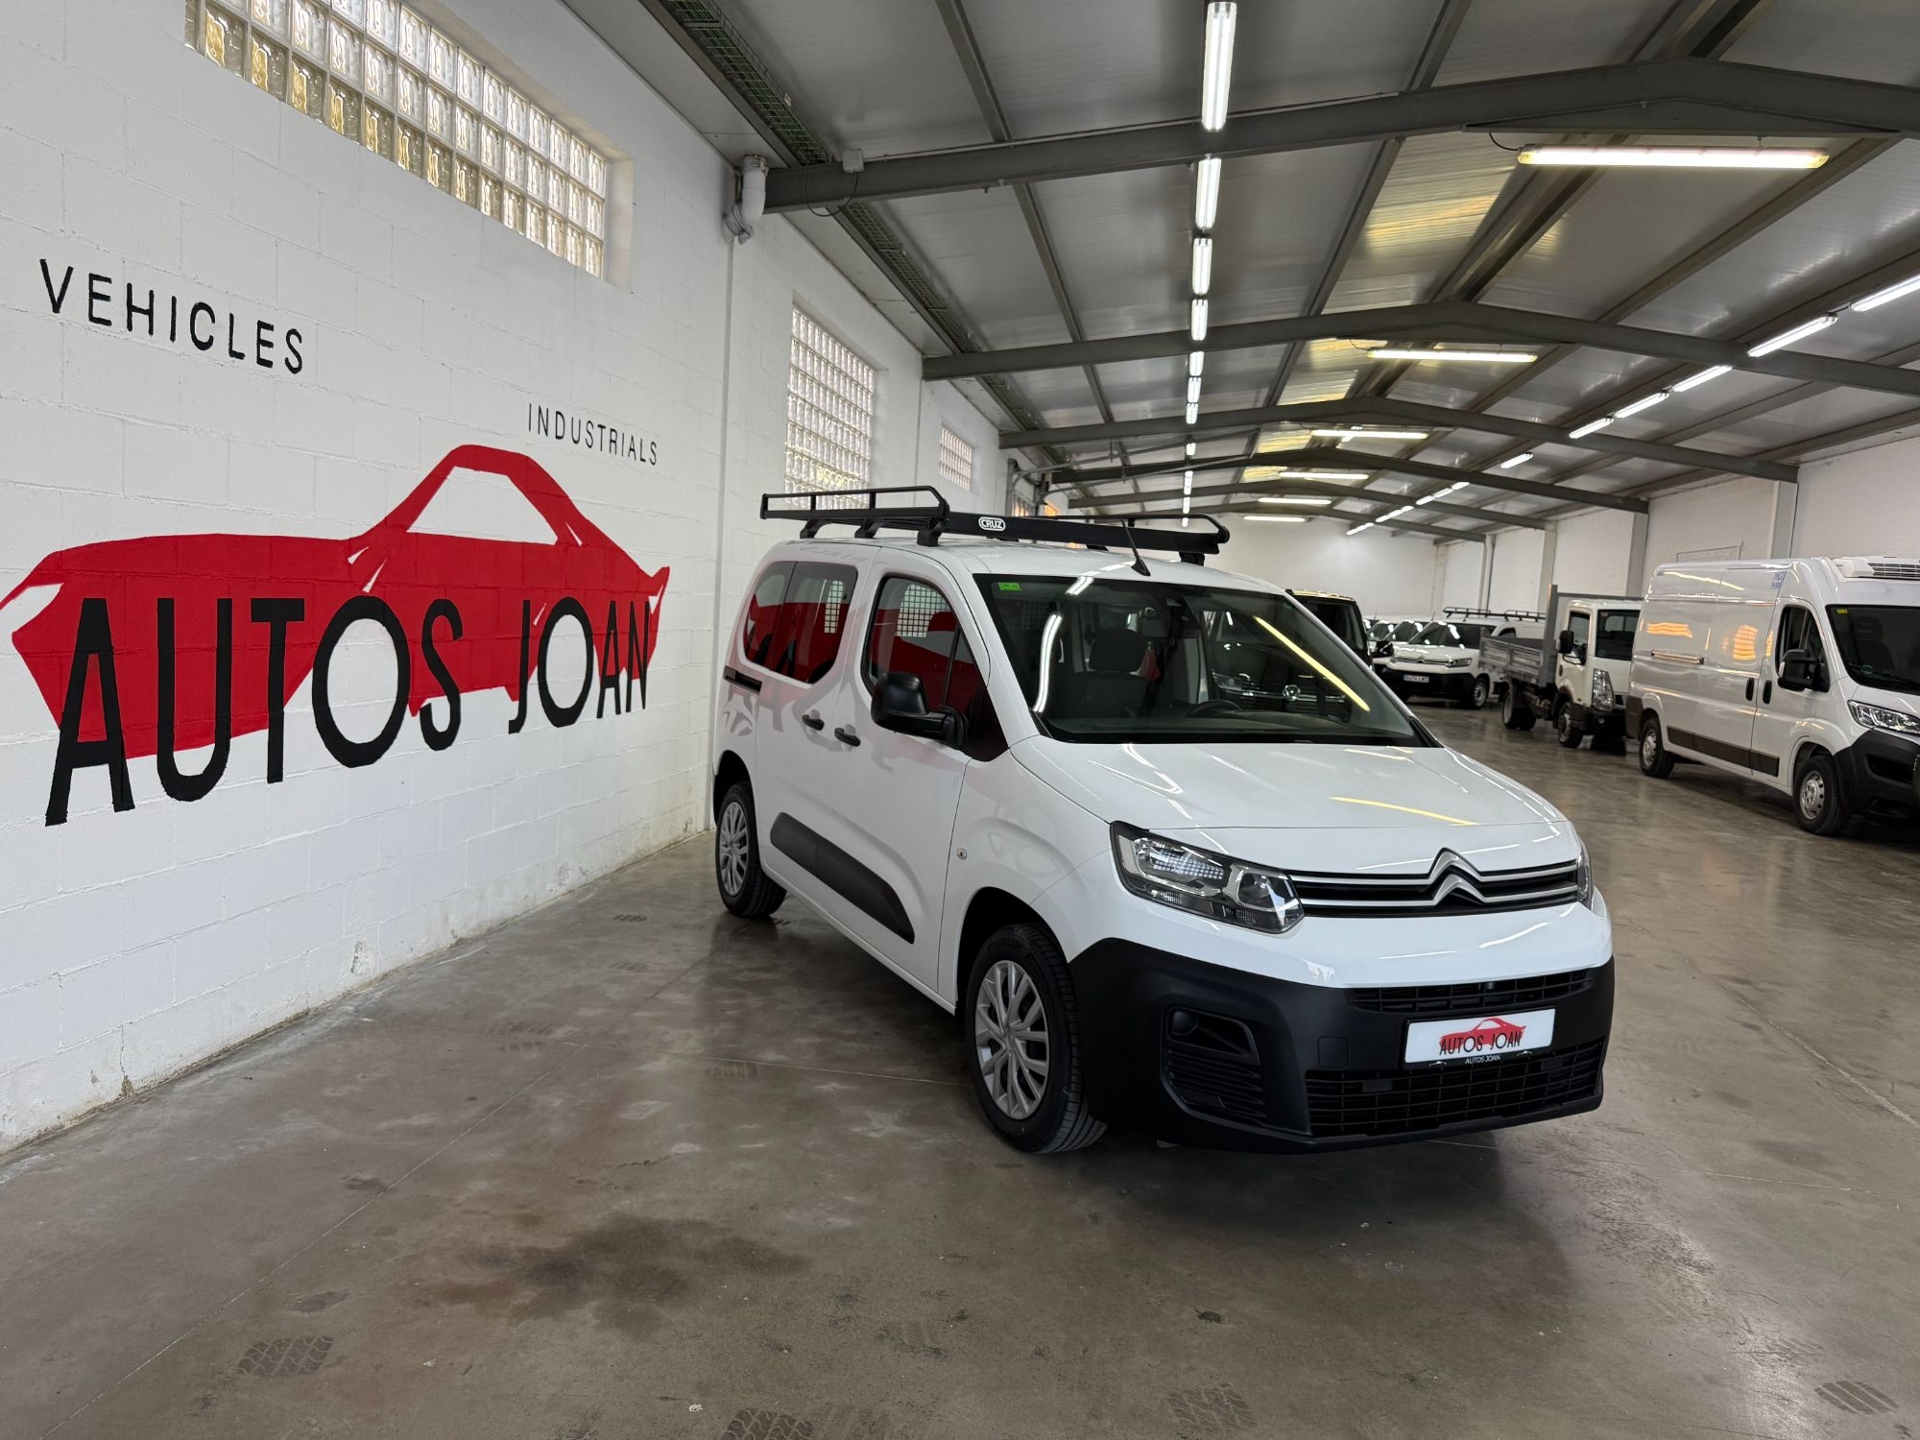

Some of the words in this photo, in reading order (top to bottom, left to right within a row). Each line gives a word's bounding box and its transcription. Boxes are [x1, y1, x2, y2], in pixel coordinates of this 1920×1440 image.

[39, 258, 303, 375] VEHICLES
[527, 403, 658, 466] INDUSTRIALS
[981, 519, 1003, 529] CRUZ
[44, 595, 464, 827] AUTOS
[508, 596, 652, 735] JOAN
[1439, 1035, 1484, 1055] AUTOS
[1490, 1031, 1522, 1050] JOAN
[1465, 1056, 1485, 1064] AUTOS
[1485, 1054, 1500, 1062] JOAN
